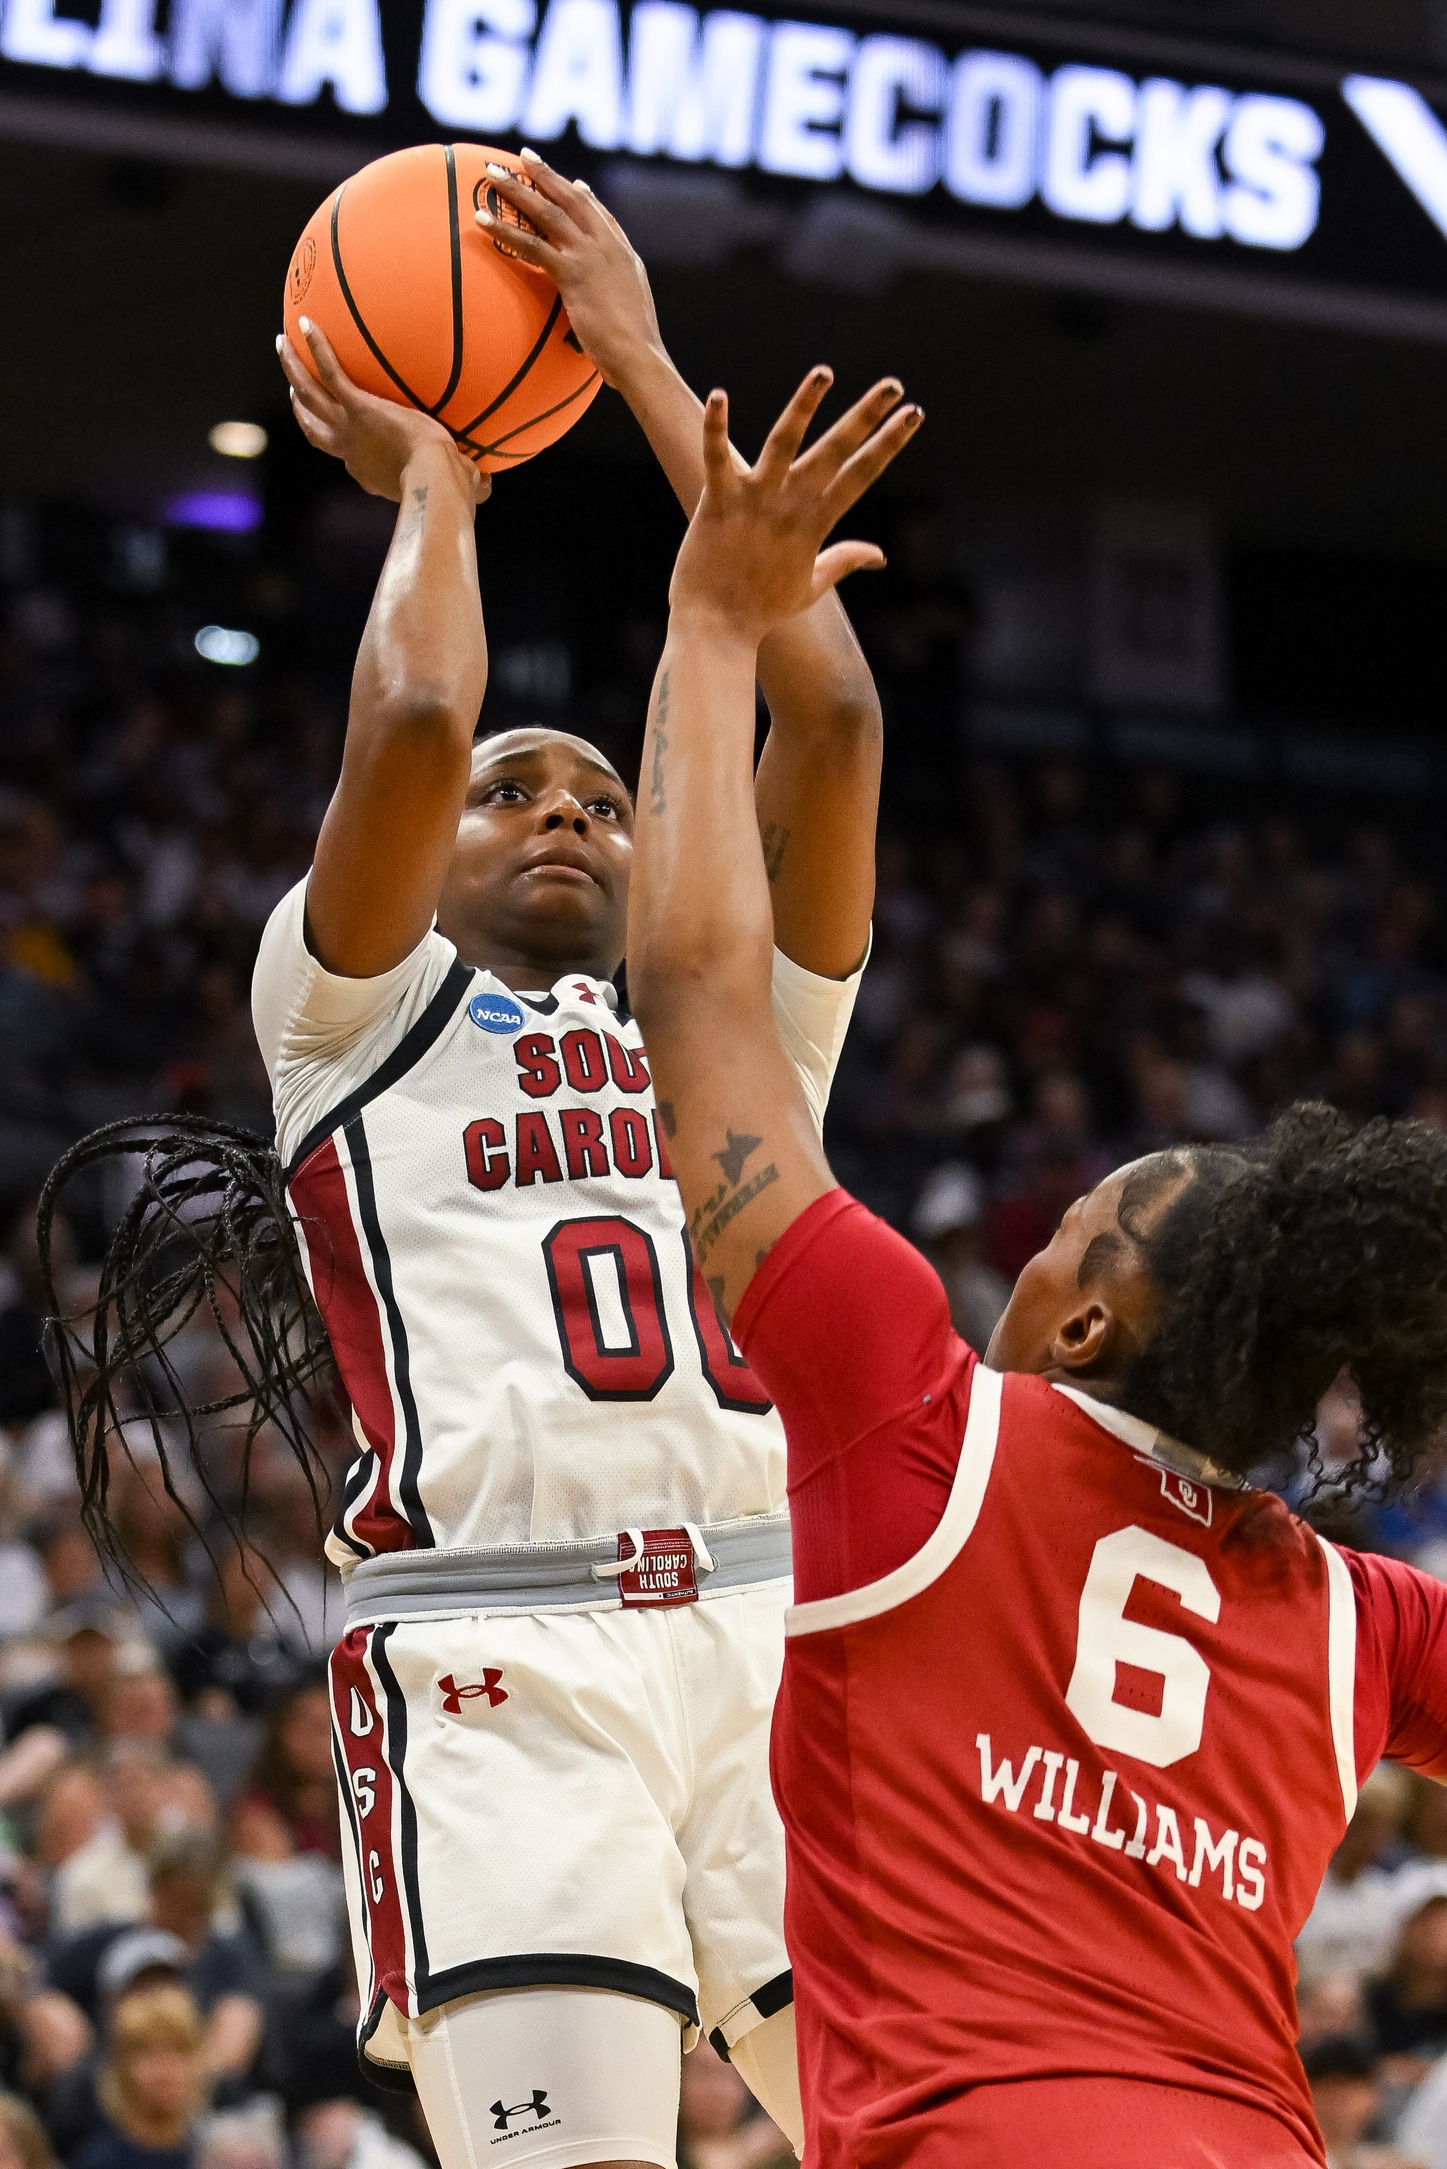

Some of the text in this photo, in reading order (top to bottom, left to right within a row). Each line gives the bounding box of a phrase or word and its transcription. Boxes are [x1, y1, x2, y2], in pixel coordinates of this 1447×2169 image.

[415, 0, 1326, 251] GAMECOCKS
[477, 1008, 521, 1025] NCAA
[640, 1572, 679, 1589] SOUTH
[1065, 1524, 1222, 1769] 6
[975, 1733, 1267, 1911] WILLIAMS
[490, 2119, 561, 2145] UNDER ARMOUR
